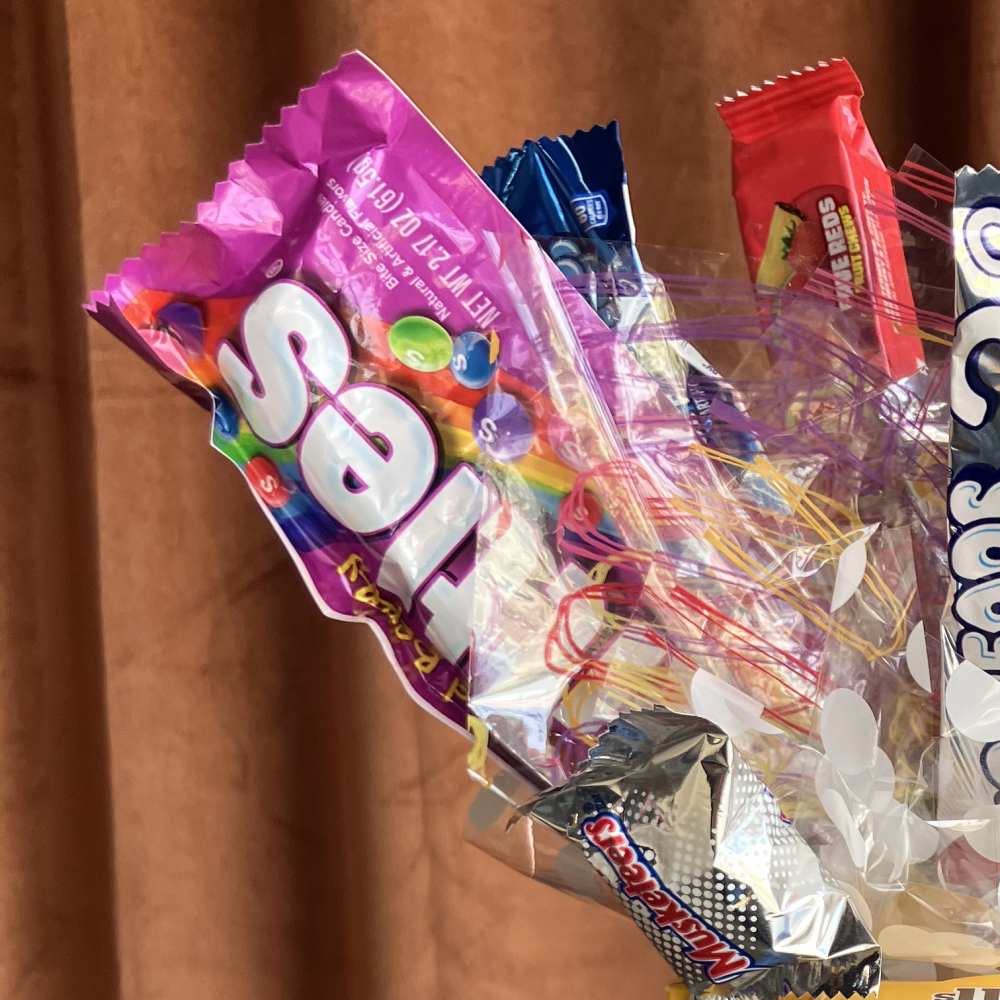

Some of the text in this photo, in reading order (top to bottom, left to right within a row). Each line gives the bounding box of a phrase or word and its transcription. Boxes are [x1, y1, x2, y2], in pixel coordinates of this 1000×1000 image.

[390, 206, 423, 238] OZ
[818, 195, 849, 256] REDS
[838, 204, 862, 254] CHEWS
[327, 177, 450, 322] Natural & Artificial Flavors
[352, 233, 378, 265] Size
[410, 233, 451, 272] 2.17
[376, 259, 400, 291] Bite
[439, 264, 474, 300] WT
[461, 297, 501, 329] NET
[583, 817, 751, 979] Musketeers
